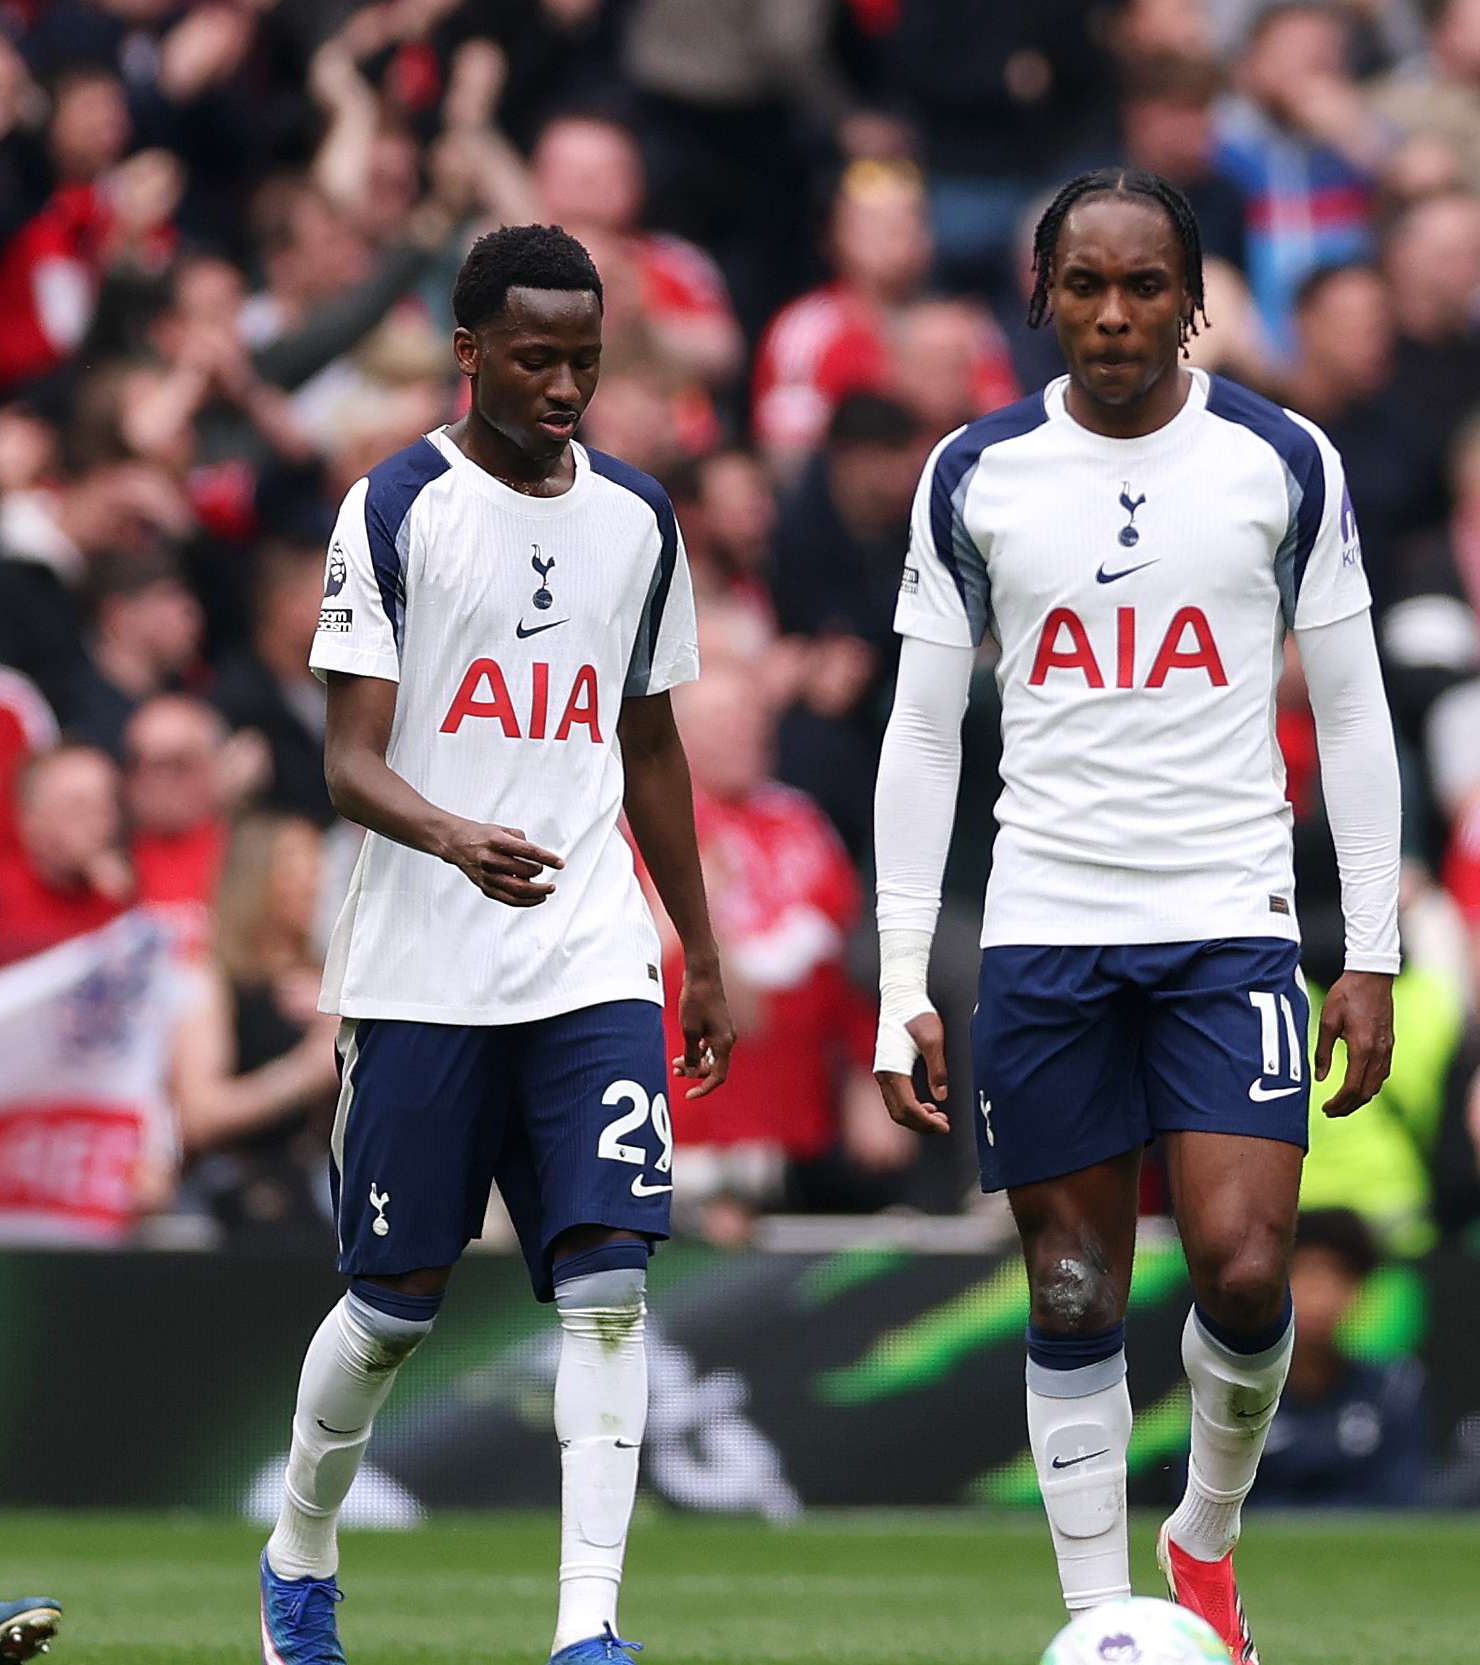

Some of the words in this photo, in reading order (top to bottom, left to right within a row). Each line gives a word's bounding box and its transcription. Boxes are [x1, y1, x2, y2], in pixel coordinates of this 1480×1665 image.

[317, 621, 352, 632] acism
[319, 610, 347, 623] oom
[1028, 606, 1229, 690] AIA
[439, 658, 604, 744] AIA
[1248, 991, 1302, 1083] 11
[597, 1079, 673, 1173] 29
